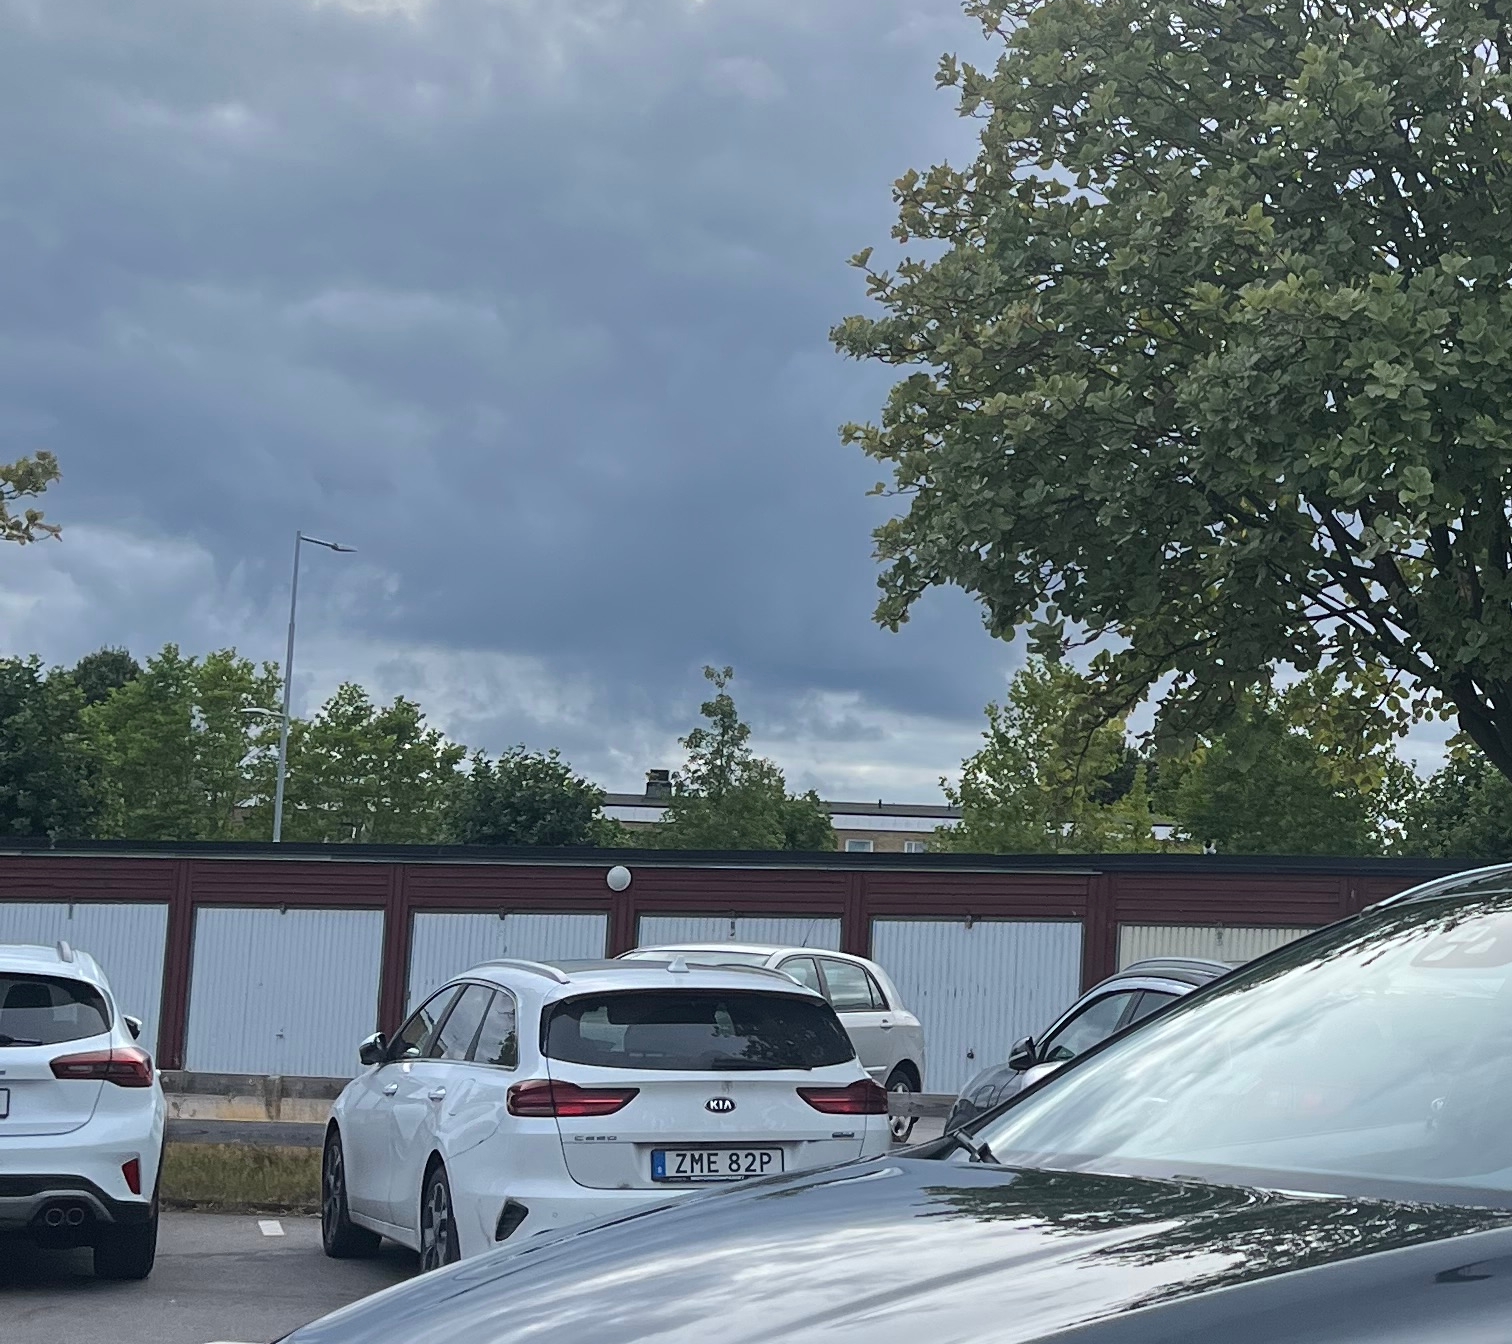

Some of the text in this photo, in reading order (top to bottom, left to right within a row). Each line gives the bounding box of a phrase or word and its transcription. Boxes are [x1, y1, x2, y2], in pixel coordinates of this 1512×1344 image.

[709, 1099, 732, 1110] KIA
[675, 1152, 772, 1174] ZME 82P
